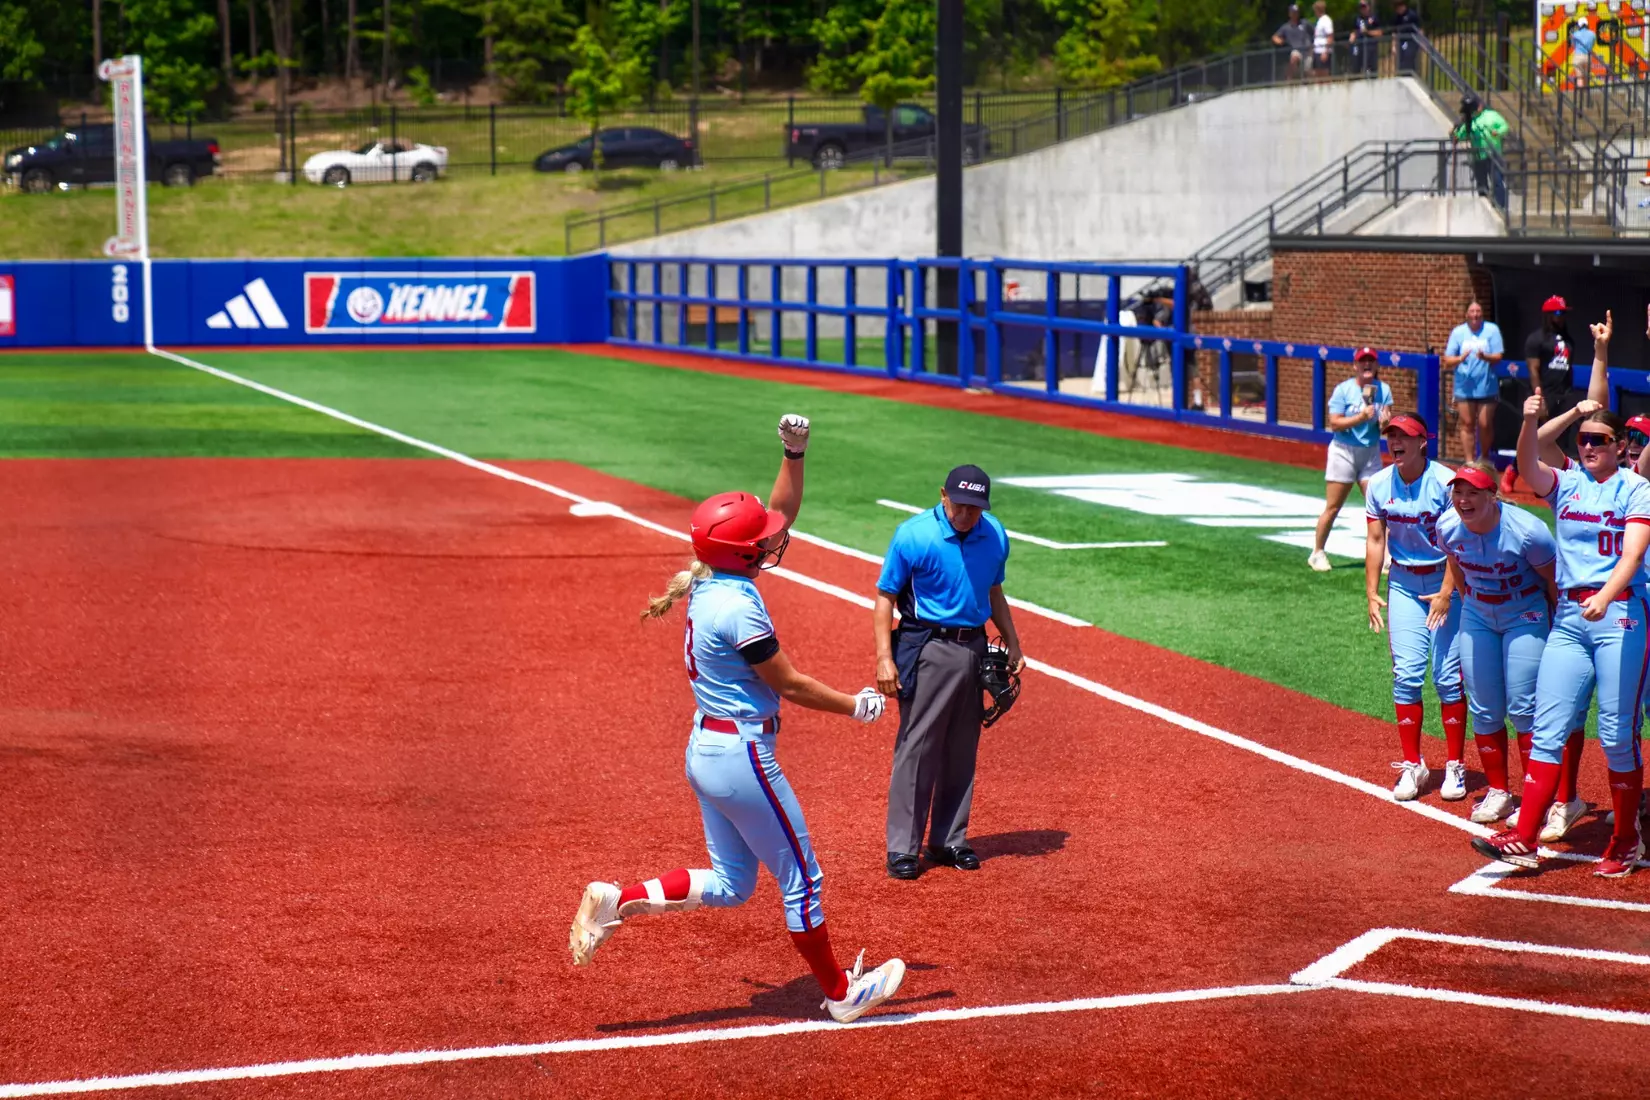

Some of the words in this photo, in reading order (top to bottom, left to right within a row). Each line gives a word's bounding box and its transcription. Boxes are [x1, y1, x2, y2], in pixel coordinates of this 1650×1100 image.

[112, 264, 129, 323] 200
[384, 284, 488, 321] KENNEL
[1598, 530, 1624, 556] 00
